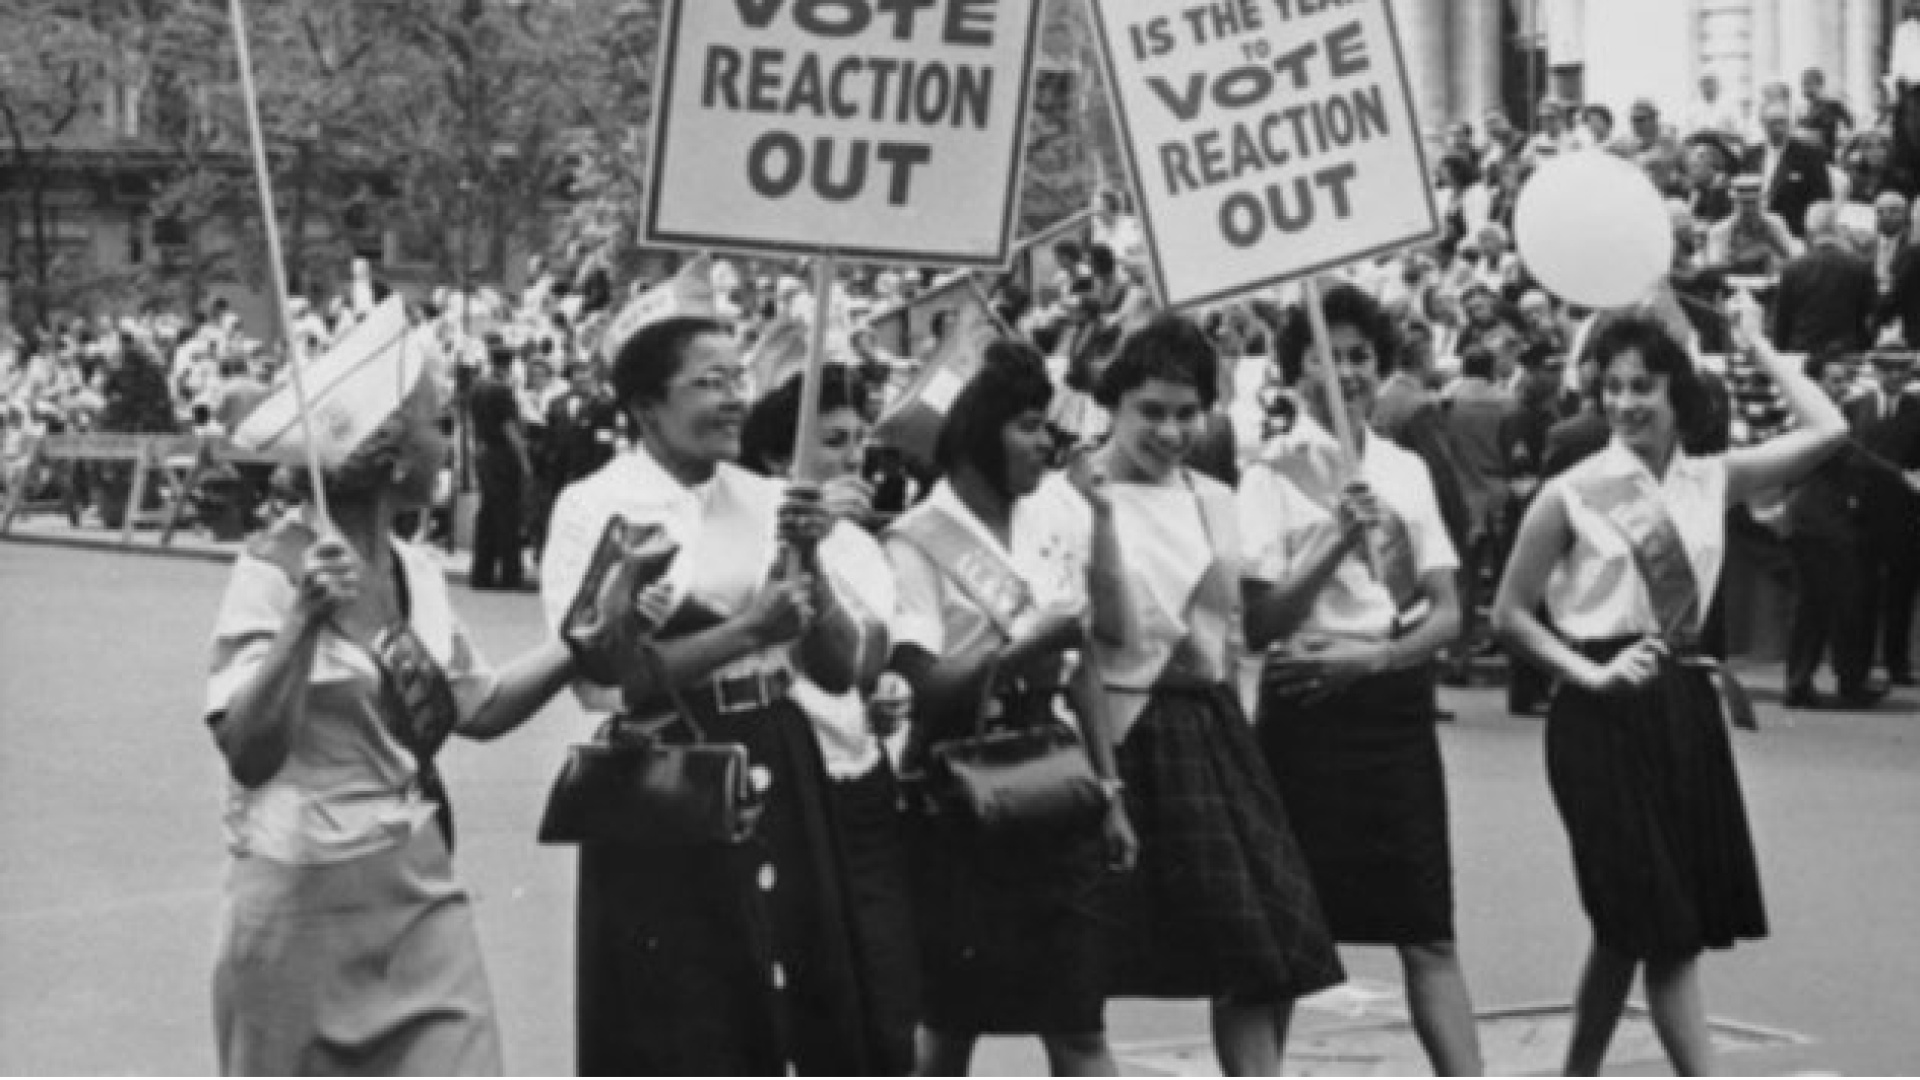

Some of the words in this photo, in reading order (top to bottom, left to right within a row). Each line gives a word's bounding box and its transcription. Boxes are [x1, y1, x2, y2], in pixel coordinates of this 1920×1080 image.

[732, 0, 998, 46] VOTE
[1128, 17, 1175, 62] IS
[1182, 0, 1262, 45] THE
[701, 44, 993, 129] REACTION
[1146, 20, 1370, 121] VOTE
[747, 130, 931, 207] OUT
[1158, 83, 1389, 196] REACTION
[1217, 161, 1357, 248] OUT
